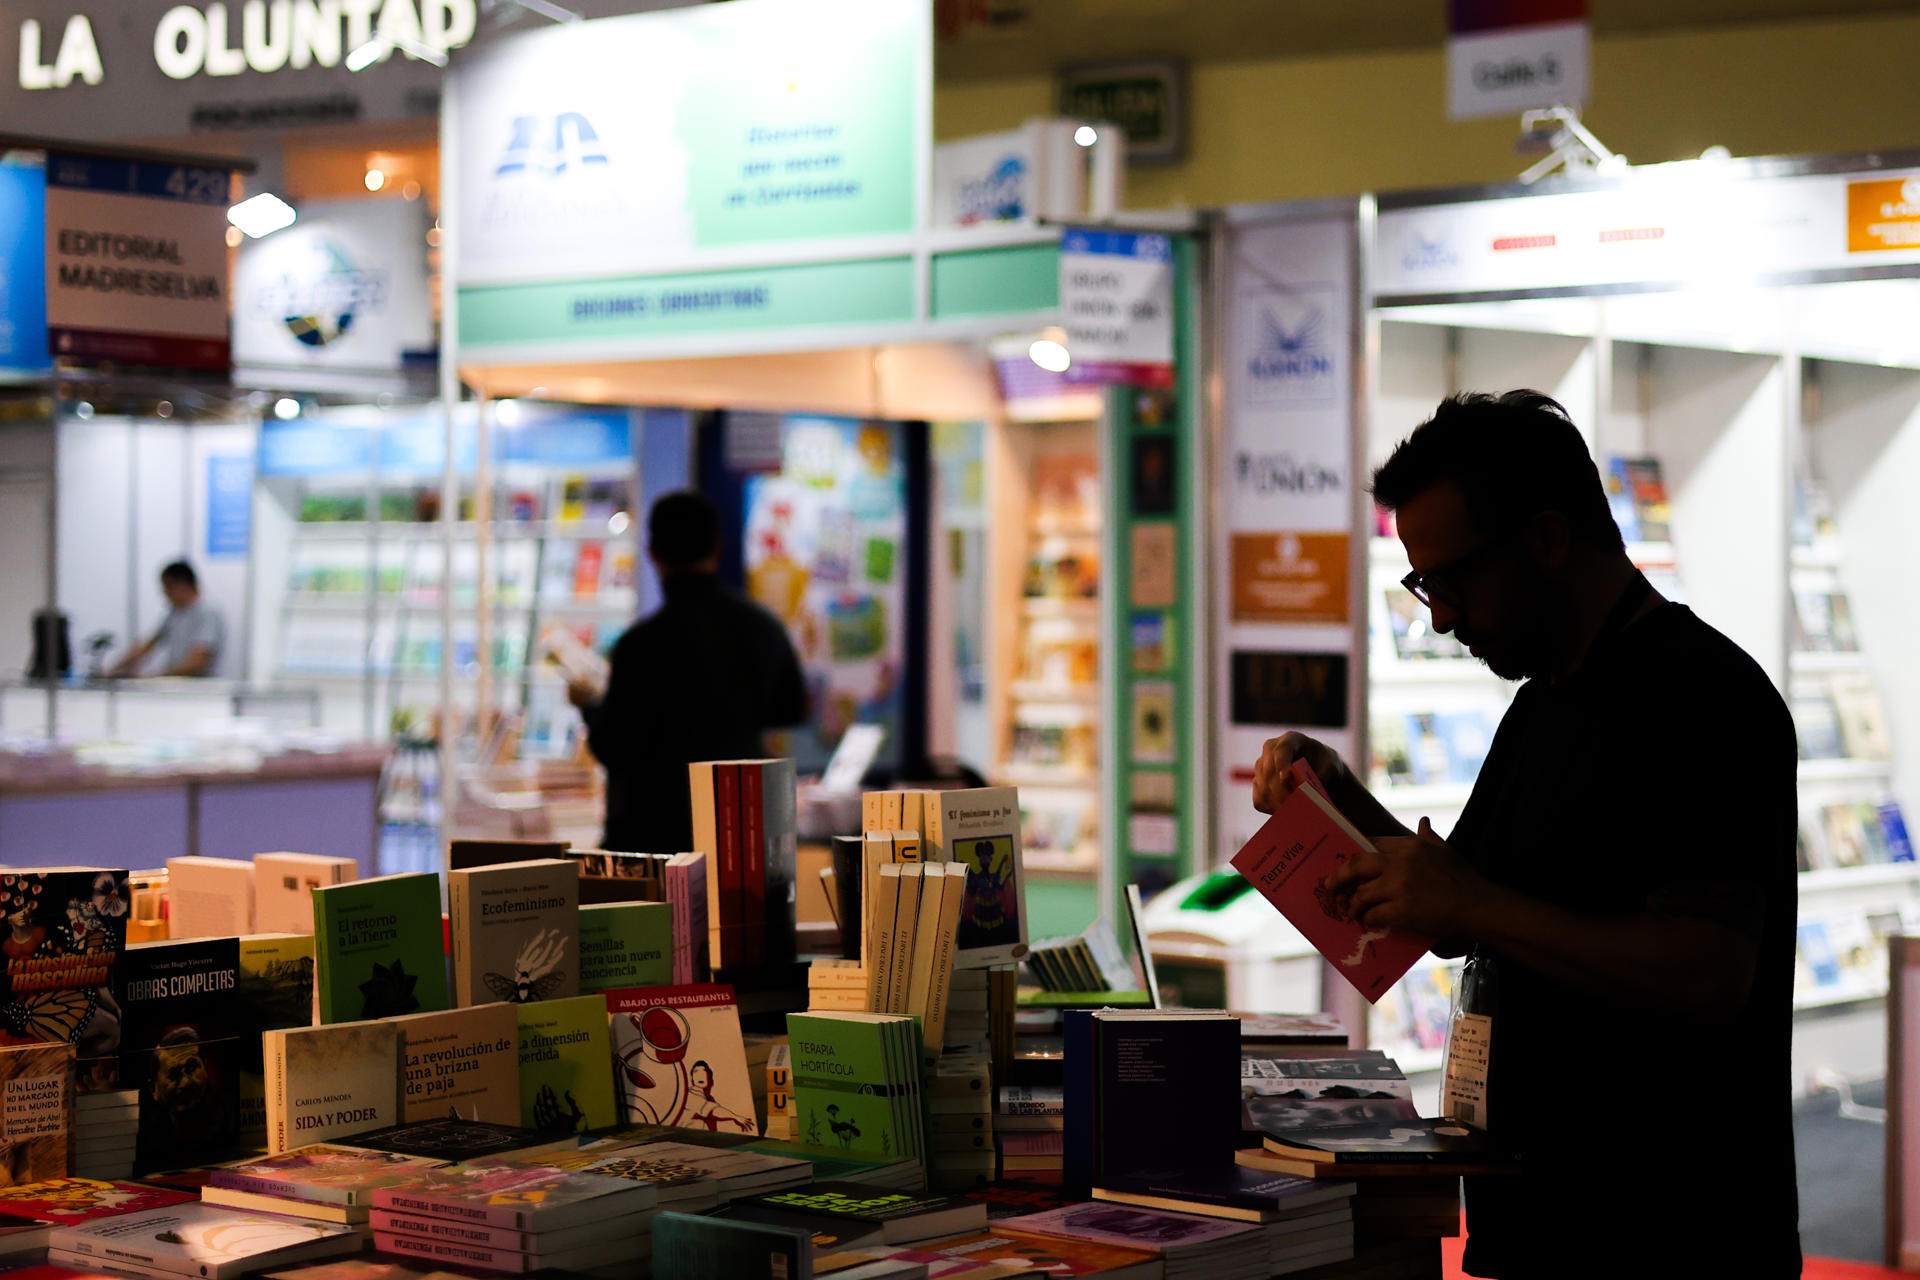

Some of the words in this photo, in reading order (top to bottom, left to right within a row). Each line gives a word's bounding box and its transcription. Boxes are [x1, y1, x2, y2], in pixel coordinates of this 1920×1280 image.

[18, 14, 104, 90] LA
[59, 229, 184, 265] EDITORIAL
[59, 263, 221, 301] MADRESELVA
[1261, 862, 1288, 886] Terra
[1282, 840, 1304, 868] Viva
[482, 896, 566, 916] Ecofeminismo
[338, 919, 350, 933] El
[352, 914, 397, 931] retorno
[339, 937, 346, 947] a
[348, 934, 358, 945] la
[360, 928, 397, 943] Tierra
[580, 939, 624, 953] Semillas
[7, 958, 24, 975] La
[25, 947, 117, 973] prostitución
[580, 955, 604, 969] para
[608, 953, 627, 963] una
[630, 950, 661, 962] nueva
[11, 965, 109, 992] masculina
[580, 963, 637, 979] conciencia
[127, 978, 168, 1001] OBRAS
[171, 969, 235, 996] COMPLETAS
[619, 996, 648, 1008] ABAJO
[650, 994, 666, 1006] LOS
[667, 992, 731, 1005] RESTAURANTES
[531, 1029, 590, 1048] dimensión
[405, 1054, 419, 1066] La
[423, 1041, 493, 1064] revolución
[495, 1038, 511, 1052] de
[799, 1042, 836, 1056] TERAPIA
[406, 1067, 432, 1080] una
[435, 1059, 480, 1076] brizna
[800, 1059, 855, 1076] HORTÍCOLA
[25, 1080, 59, 1092] LUGAR
[406, 1081, 422, 1095] de
[426, 1076, 455, 1095] paja
[18, 1091, 59, 1101] MARCADO
[29, 1100, 59, 1110] MUNDO
[295, 1099, 322, 1107] CARLOS
[324, 1093, 352, 1103] MENDES
[38, 1114, 46, 1122] de
[295, 1115, 324, 1130] SIDA
[326, 1114, 334, 1126] Y
[337, 1107, 377, 1125] PODER
[392, 1198, 429, 1211] FEMINISTAS
[390, 1219, 429, 1233] FEMINISTAS
[394, 1239, 432, 1253] FEMINISTAS
